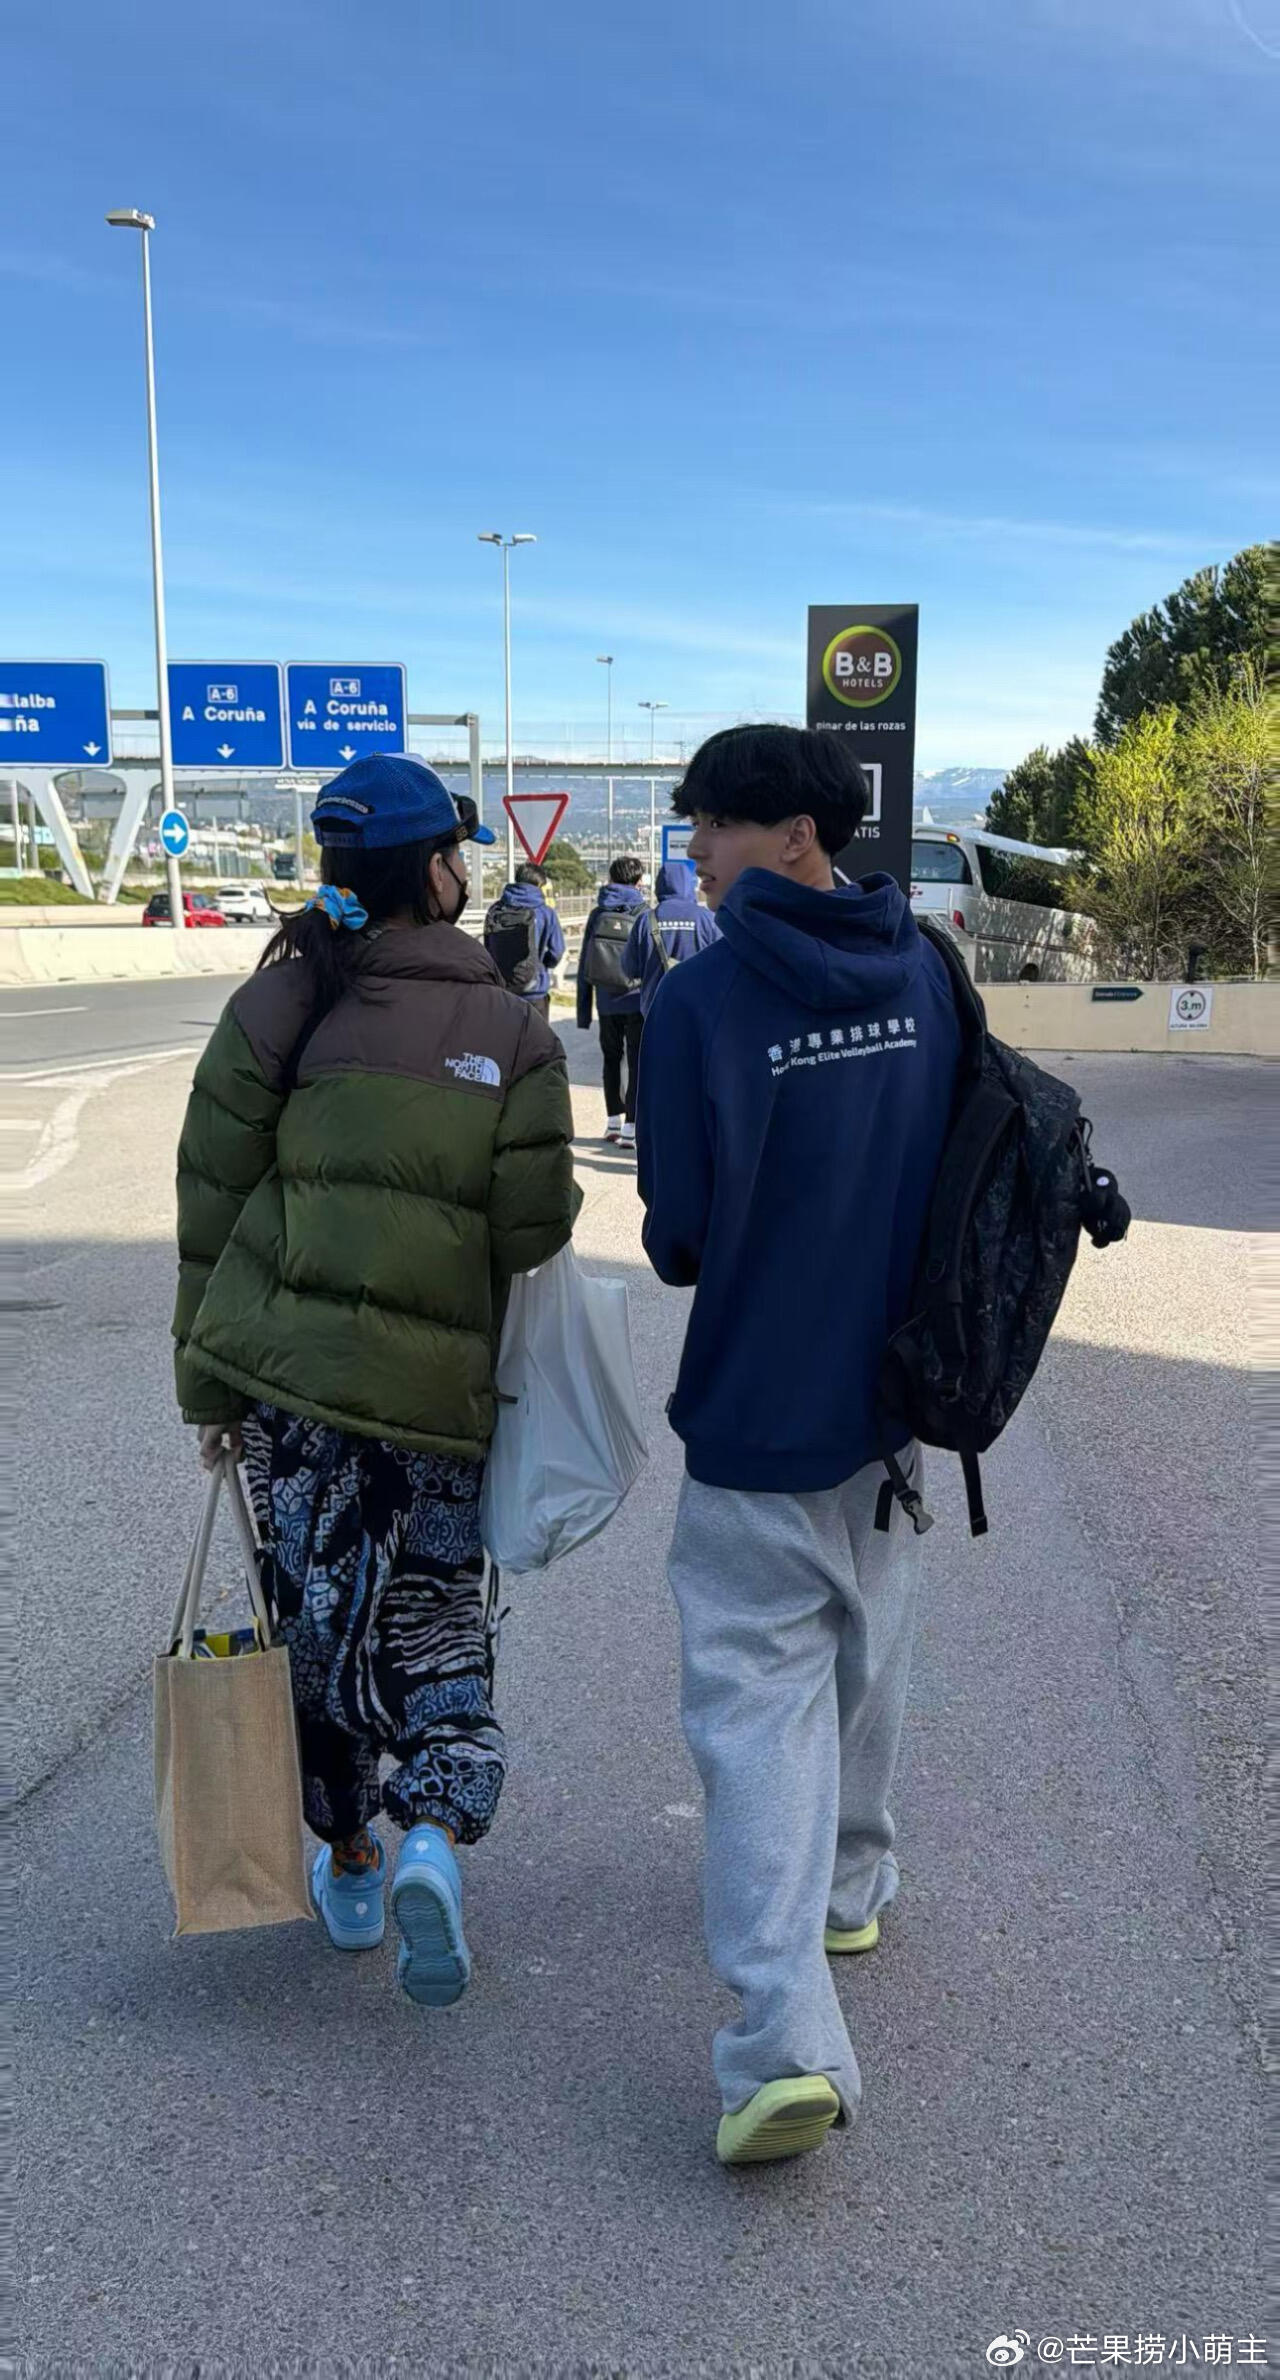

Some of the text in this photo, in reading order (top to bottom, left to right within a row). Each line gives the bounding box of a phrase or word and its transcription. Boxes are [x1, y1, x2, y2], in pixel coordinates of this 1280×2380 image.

[835, 651, 893, 677] B&B
[333, 681, 358, 694] A-6
[842, 678, 884, 688] HOTELS
[211, 687, 235, 700] A-6
[6, 692, 56, 709] lalba
[182, 705, 266, 722] A Coruña
[304, 699, 388, 716] A Coruña
[323, 718, 340, 732] de
[346, 719, 397, 732] servicio
[844, 720, 858, 731] de
[860, 720, 876, 731] las
[878, 721, 906, 731] rozas
[854, 826, 881, 839] ATIS
[463, 1052, 485, 1064] THE
[790, 1056, 817, 1066] Kong
[817, 1050, 841, 1062] Elite
[840, 1042, 884, 1058] Volleyball
[884, 1038, 917, 1050] Academy
[445, 1057, 482, 1074] NORTH
[454, 1069, 482, 1082] FACE
